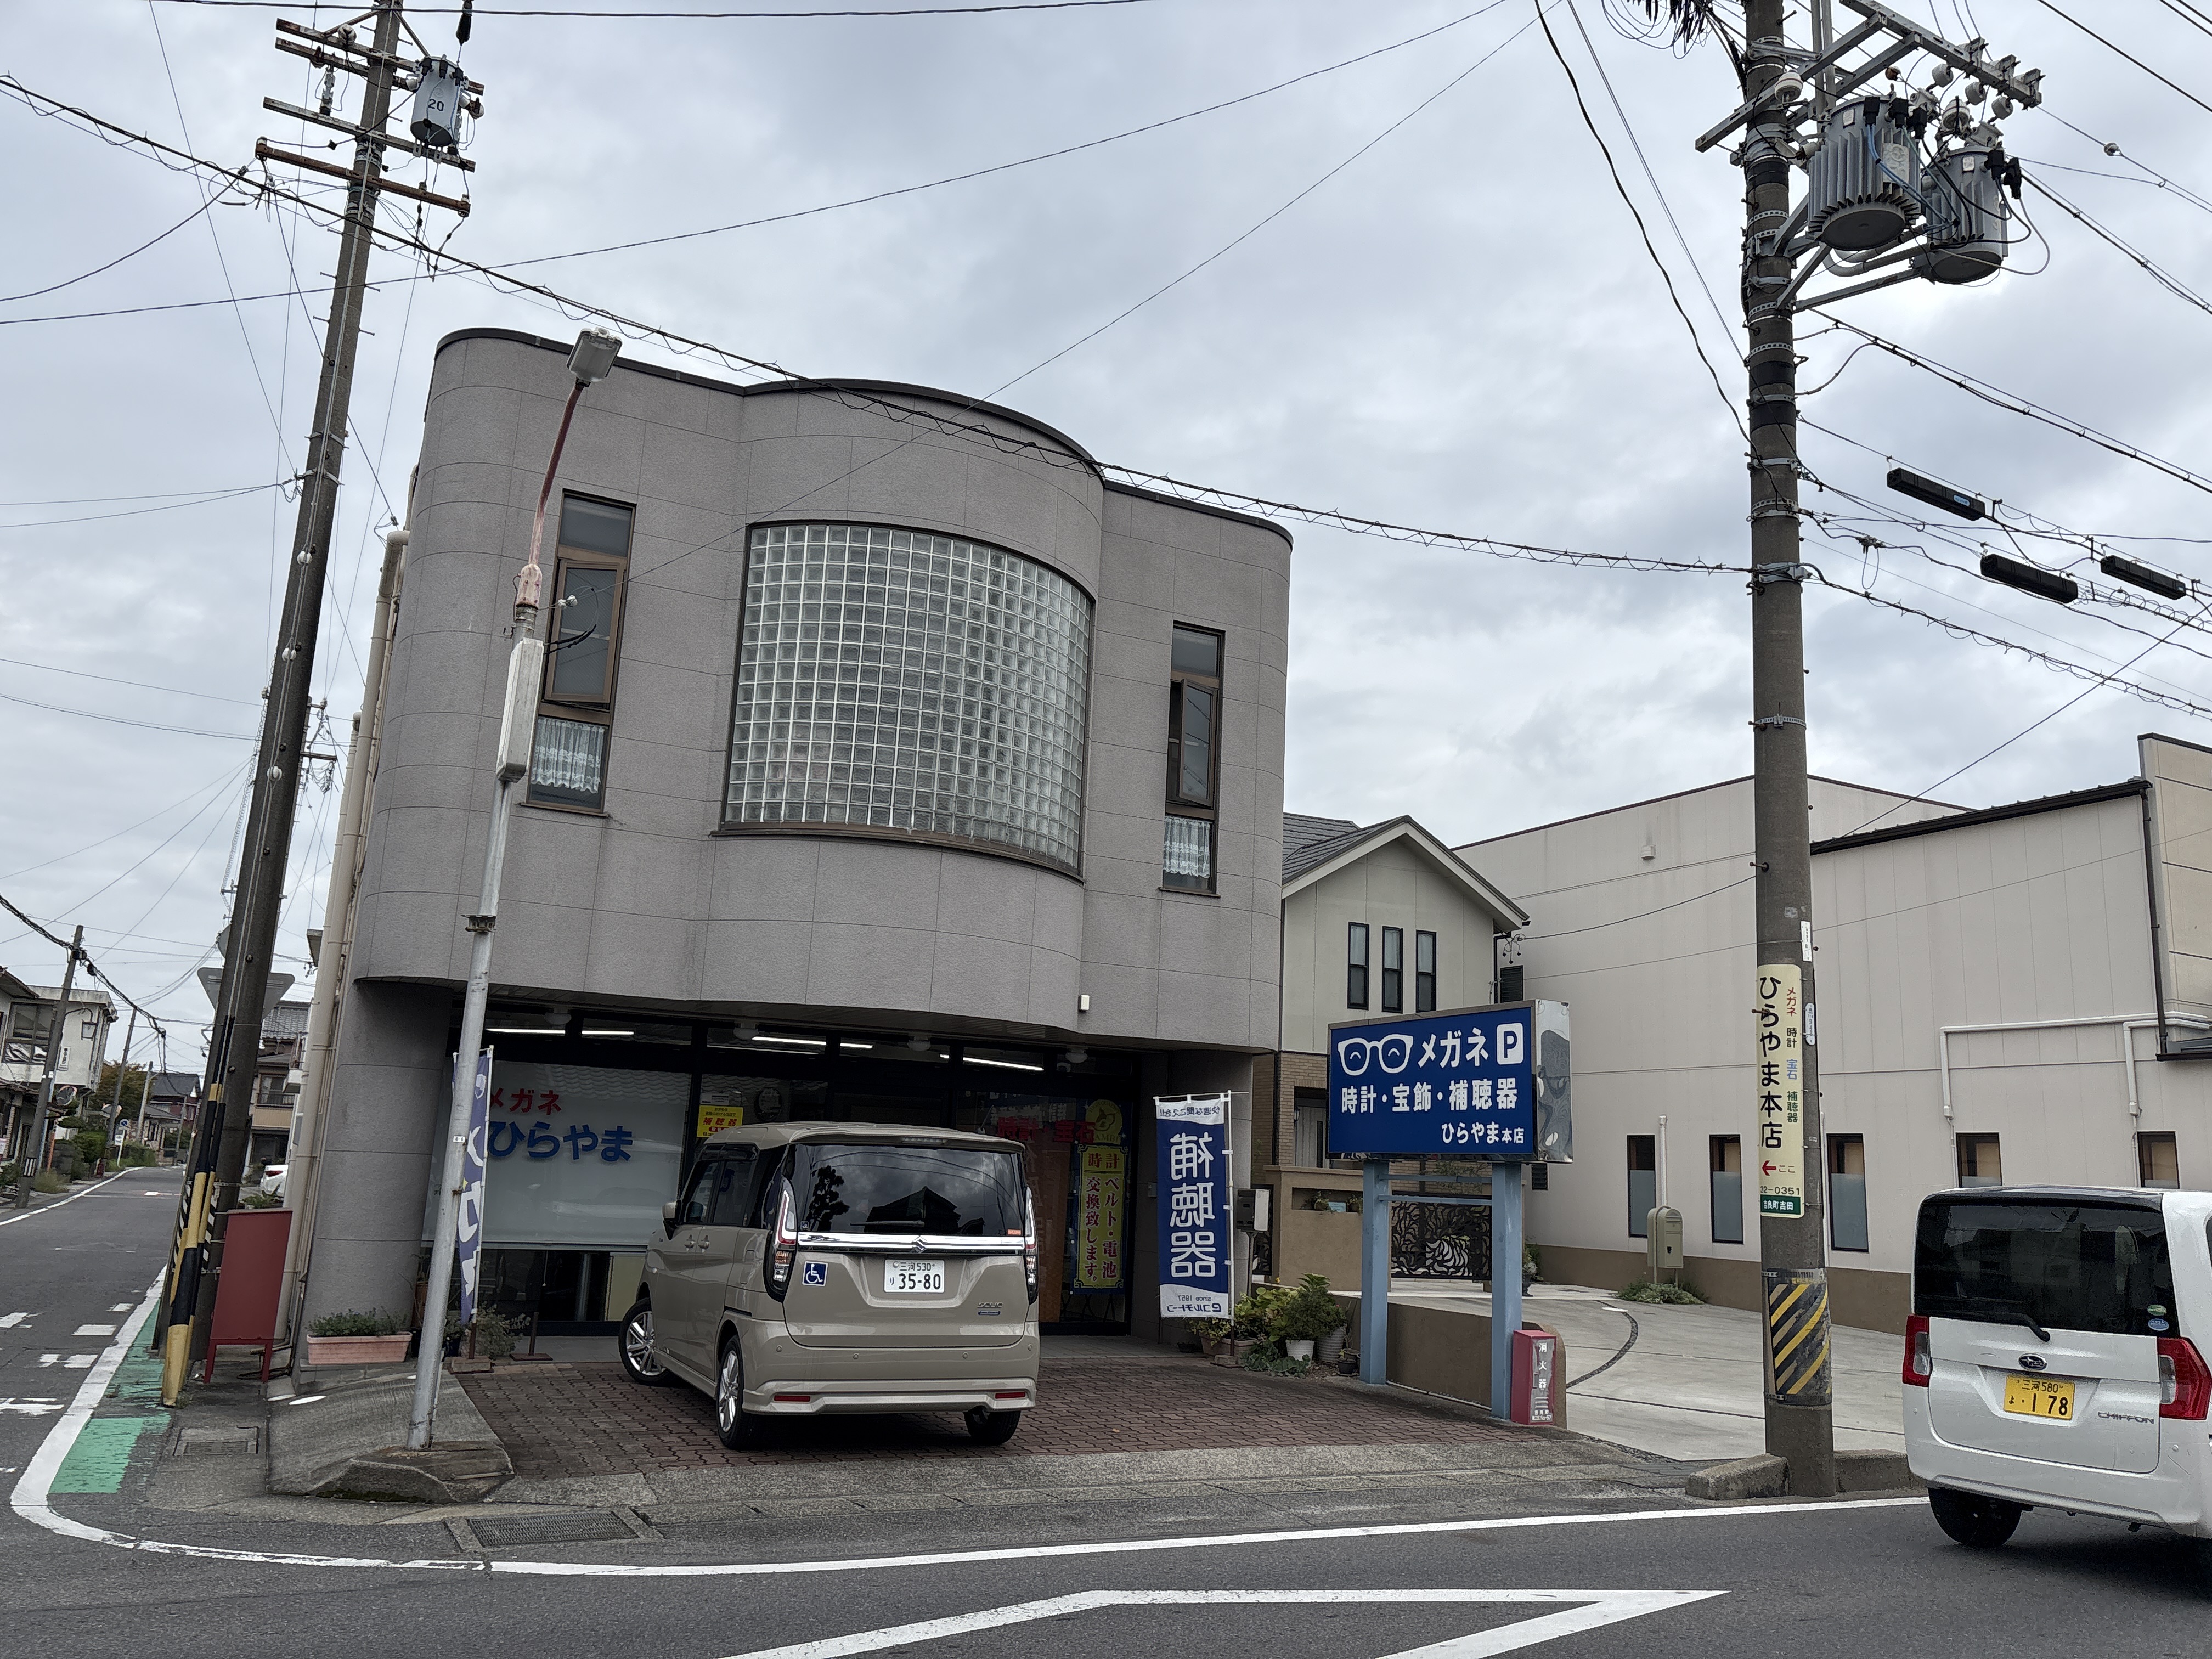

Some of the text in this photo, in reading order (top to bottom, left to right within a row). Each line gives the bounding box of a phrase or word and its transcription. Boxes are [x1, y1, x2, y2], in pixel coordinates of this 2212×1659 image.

[428, 99, 444, 112] 20
[1417, 1027, 1489, 1069] メガネ
[1759, 977, 1783, 1148] ひらやま本店
[1786, 987, 1798, 1123] メガネ 時計 宝石 補聴器
[490, 1087, 562, 1116] メガネ
[1341, 1077, 1518, 1114] 時計・宝飾・補聴器
[488, 1121, 634, 1162] ひらやま
[1441, 1121, 1525, 1144] ひらやま本店
[1088, 1153, 1120, 1169] 時計
[1778, 1165, 1796, 1173] ここ
[1760, 1186, 1801, 1195] 32-0351
[1763, 1199, 1793, 1211] 吉良町吉田
[1084, 1176, 1101, 1282] 交換致します。
[1103, 1177, 1120, 1279] ベルト・電池
[898, 1273, 941, 1290] 35-80
[1538, 1342, 1548, 1390] 消火器
[2097, 1411, 2155, 1425] CHIFFON
